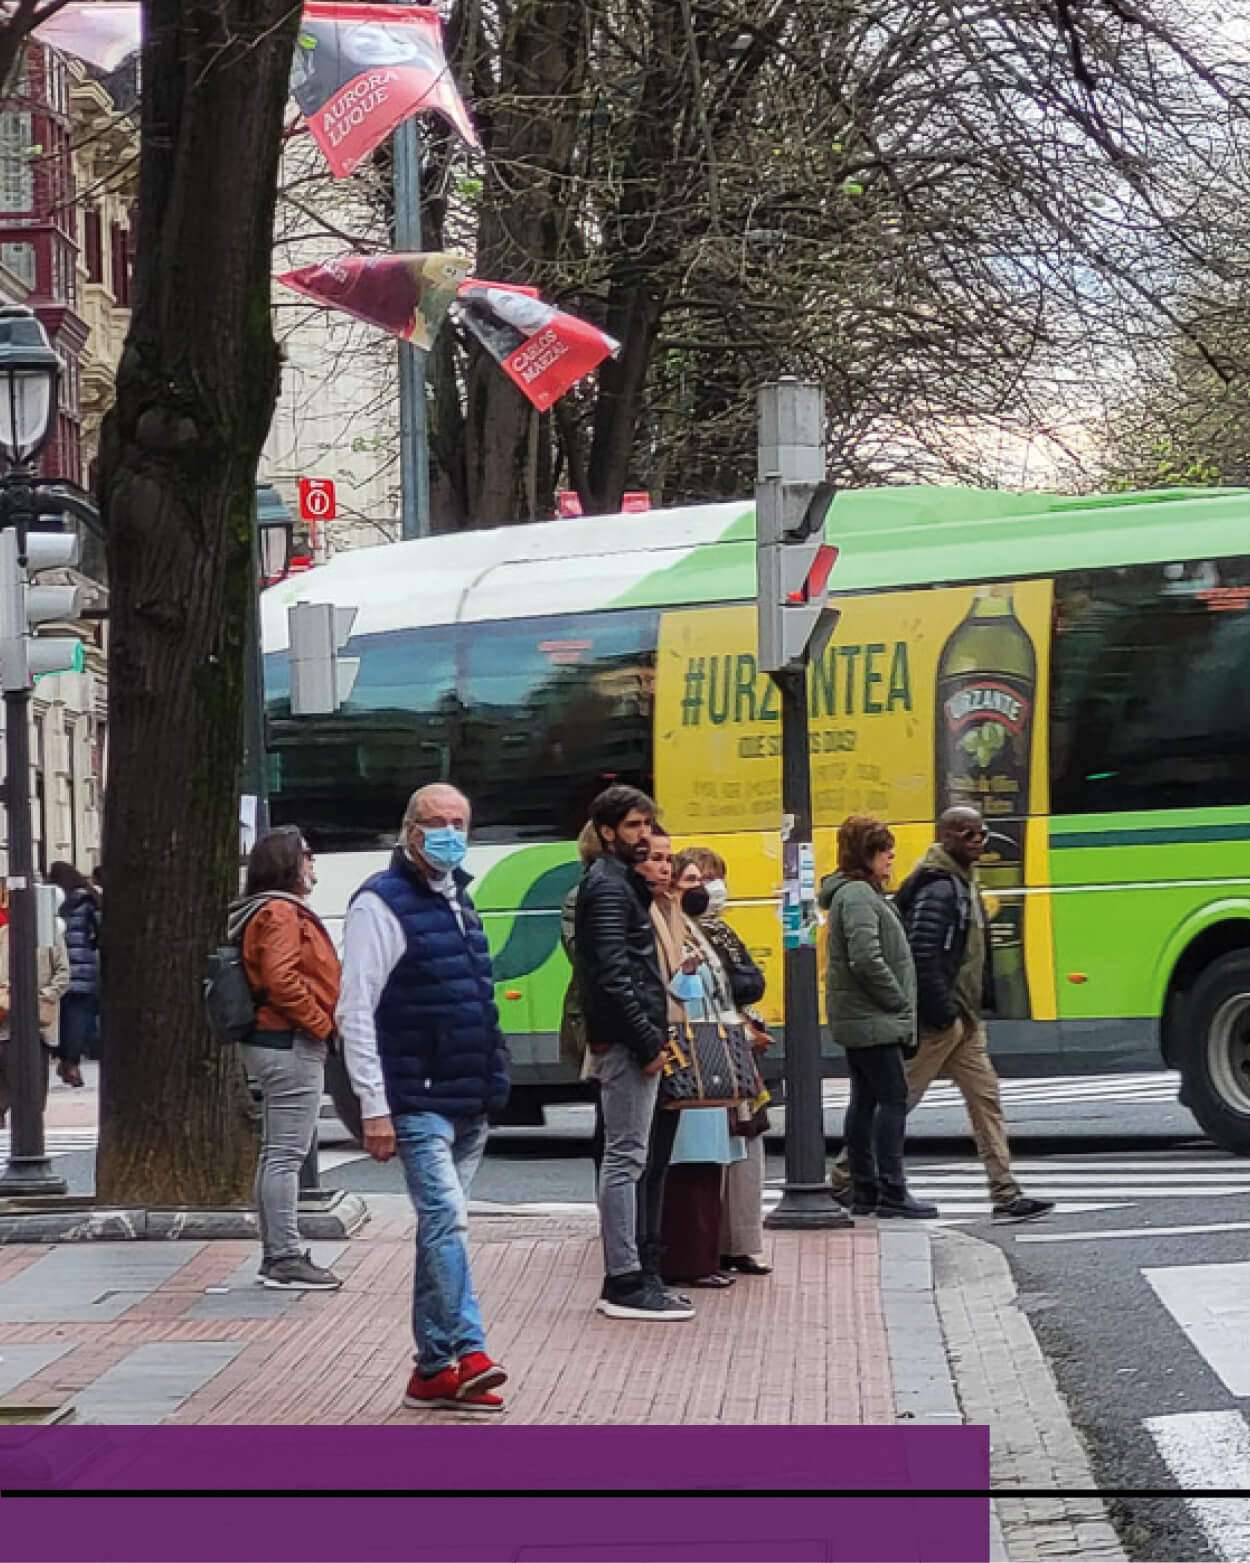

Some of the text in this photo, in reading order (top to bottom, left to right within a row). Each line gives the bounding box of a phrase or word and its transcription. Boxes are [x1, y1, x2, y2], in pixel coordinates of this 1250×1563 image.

[321, 71, 399, 132] AURORA
[328, 86, 389, 148] LUQUE
[511, 330, 558, 373] CARLOS
[681, 641, 913, 727] #URZNTEA
